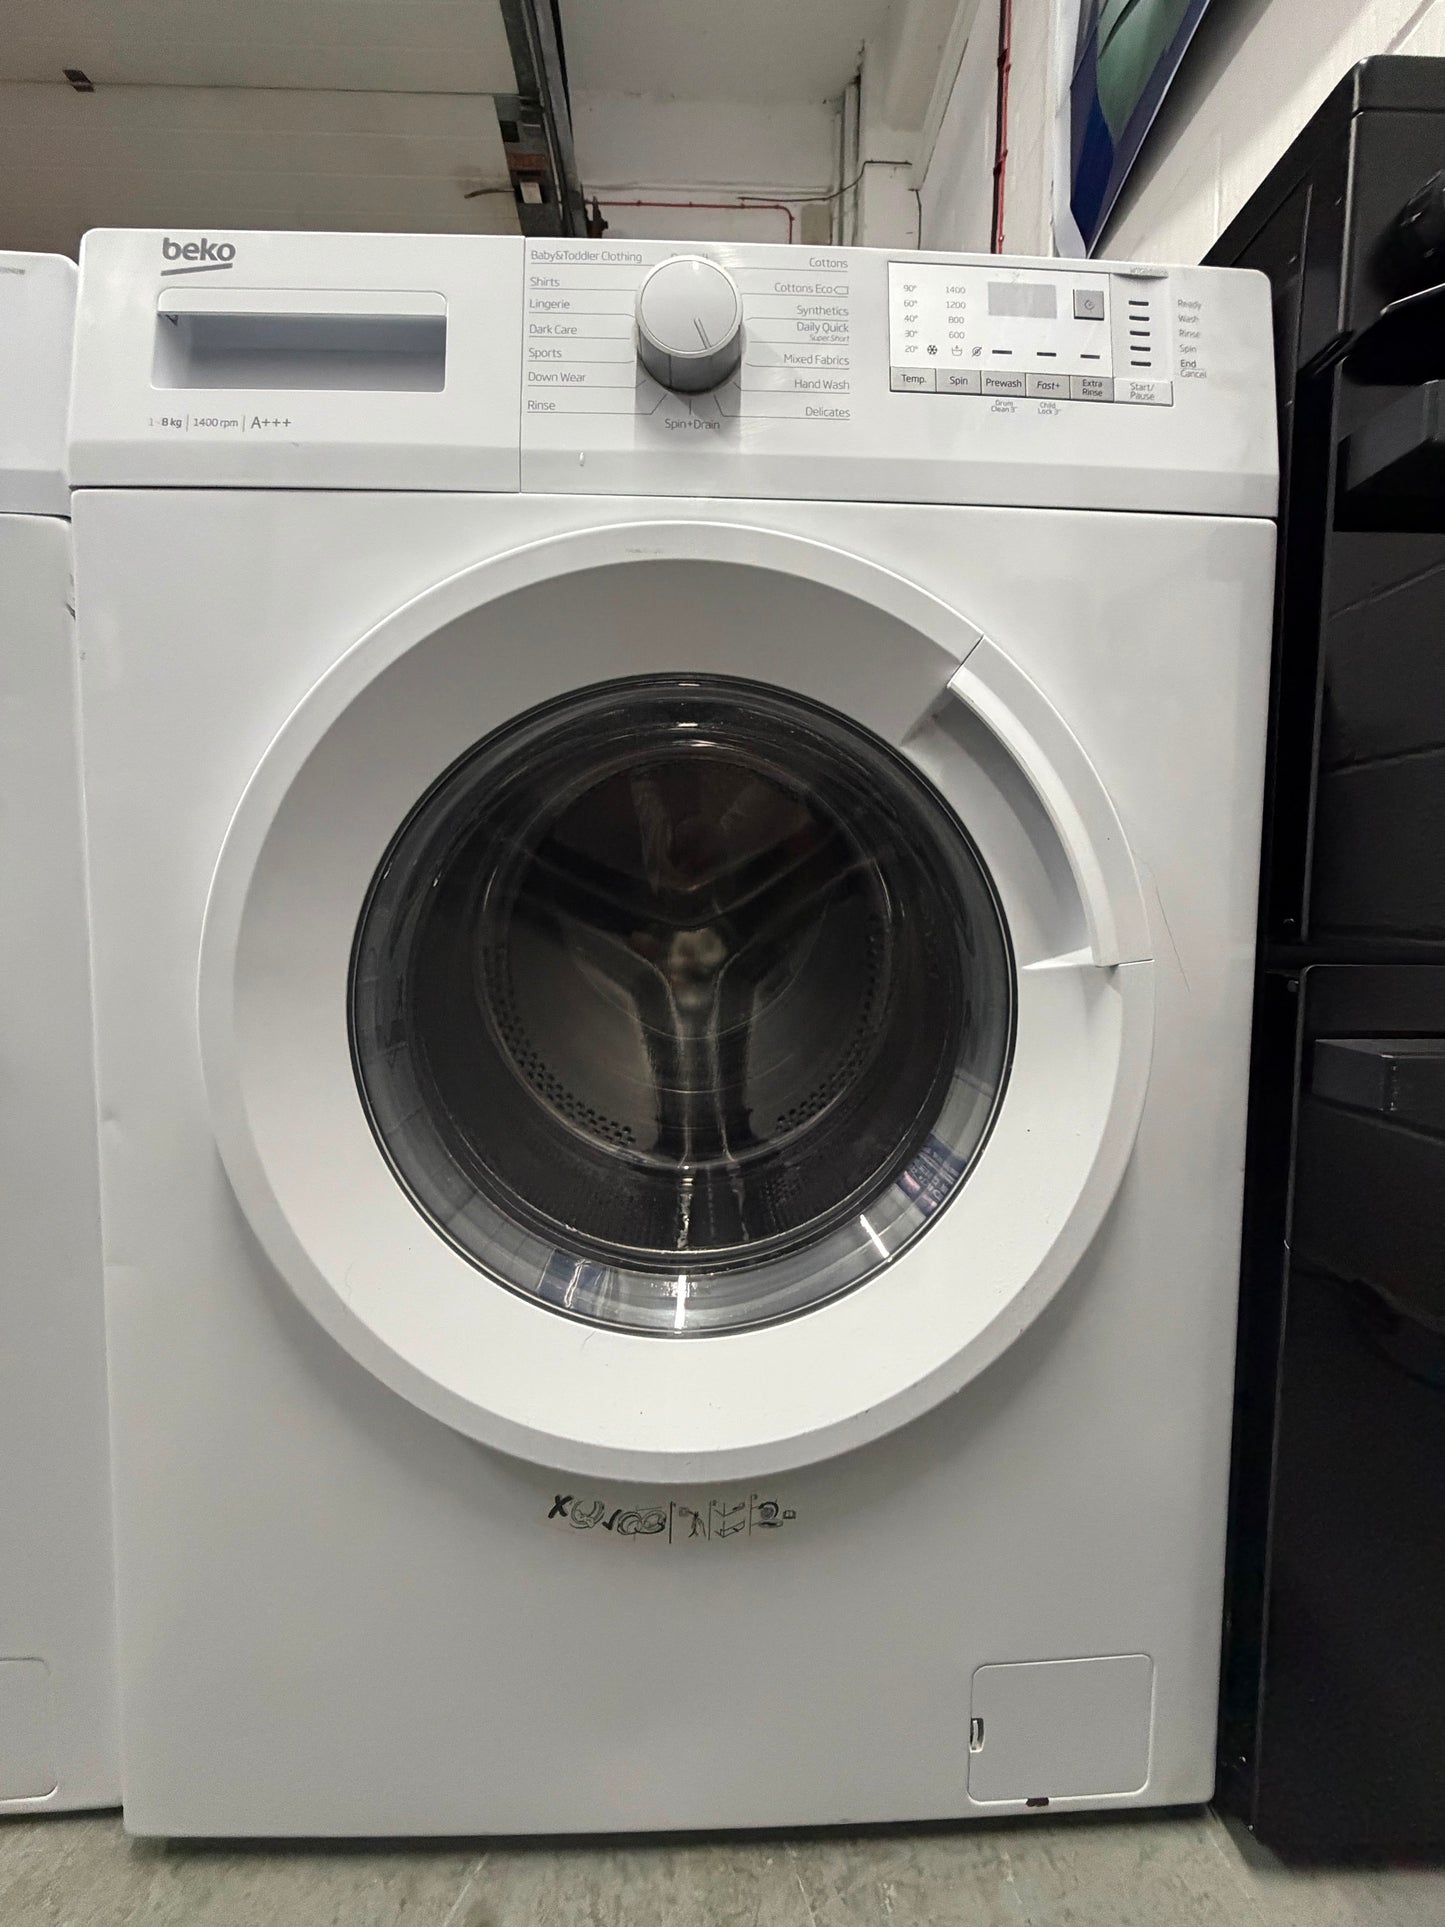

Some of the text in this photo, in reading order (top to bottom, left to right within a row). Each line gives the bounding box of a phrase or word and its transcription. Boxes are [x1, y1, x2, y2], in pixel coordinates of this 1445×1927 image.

[162, 237, 236, 261] beko
[530, 250, 642, 263] Baby&Toddler Clothing
[809, 257, 849, 268] Cottons
[529, 276, 560, 287] Shirts
[774, 282, 833, 294] Cottons Eco
[945, 286, 966, 294] 1400
[529, 299, 570, 310] Lingerie
[946, 301, 966, 309] 1200
[1177, 299, 1202, 310] Ready
[796, 305, 849, 317] Synthetics
[948, 316, 964, 324] 800
[1178, 315, 1200, 323] Wash
[529, 324, 578, 335] Dark Care
[796, 322, 849, 334] Daily Quick
[948, 331, 965, 339] 600
[1178, 329, 1201, 339] Rinse
[528, 347, 562, 359] Sports
[1179, 344, 1197, 354] Spin
[783, 354, 850, 366] Mixed Fabrics
[1180, 359, 1197, 368] End
[528, 372, 586, 383] Down Wear
[901, 374, 927, 385] Temp.
[1180, 369, 1207, 379] Cancel
[794, 379, 850, 390] Hand Wash
[949, 376, 968, 386] Spin
[985, 378, 1022, 388] Prewash
[1036, 381, 1060, 390] Fast+
[1082, 379, 1103, 387] Extra
[1130, 382, 1154, 391] Start/
[1082, 388, 1103, 397] Rinse
[1130, 391, 1155, 400] Pause
[527, 400, 556, 411] Rinse
[991, 405, 1009, 413] Clean
[1039, 401, 1056, 409] Child
[805, 406, 851, 418] Delicates
[193, 417, 218, 428] 1400
[219, 419, 239, 429] rpm
[250, 416, 292, 429] A+++
[664, 418, 720, 431] Spin+Drain
